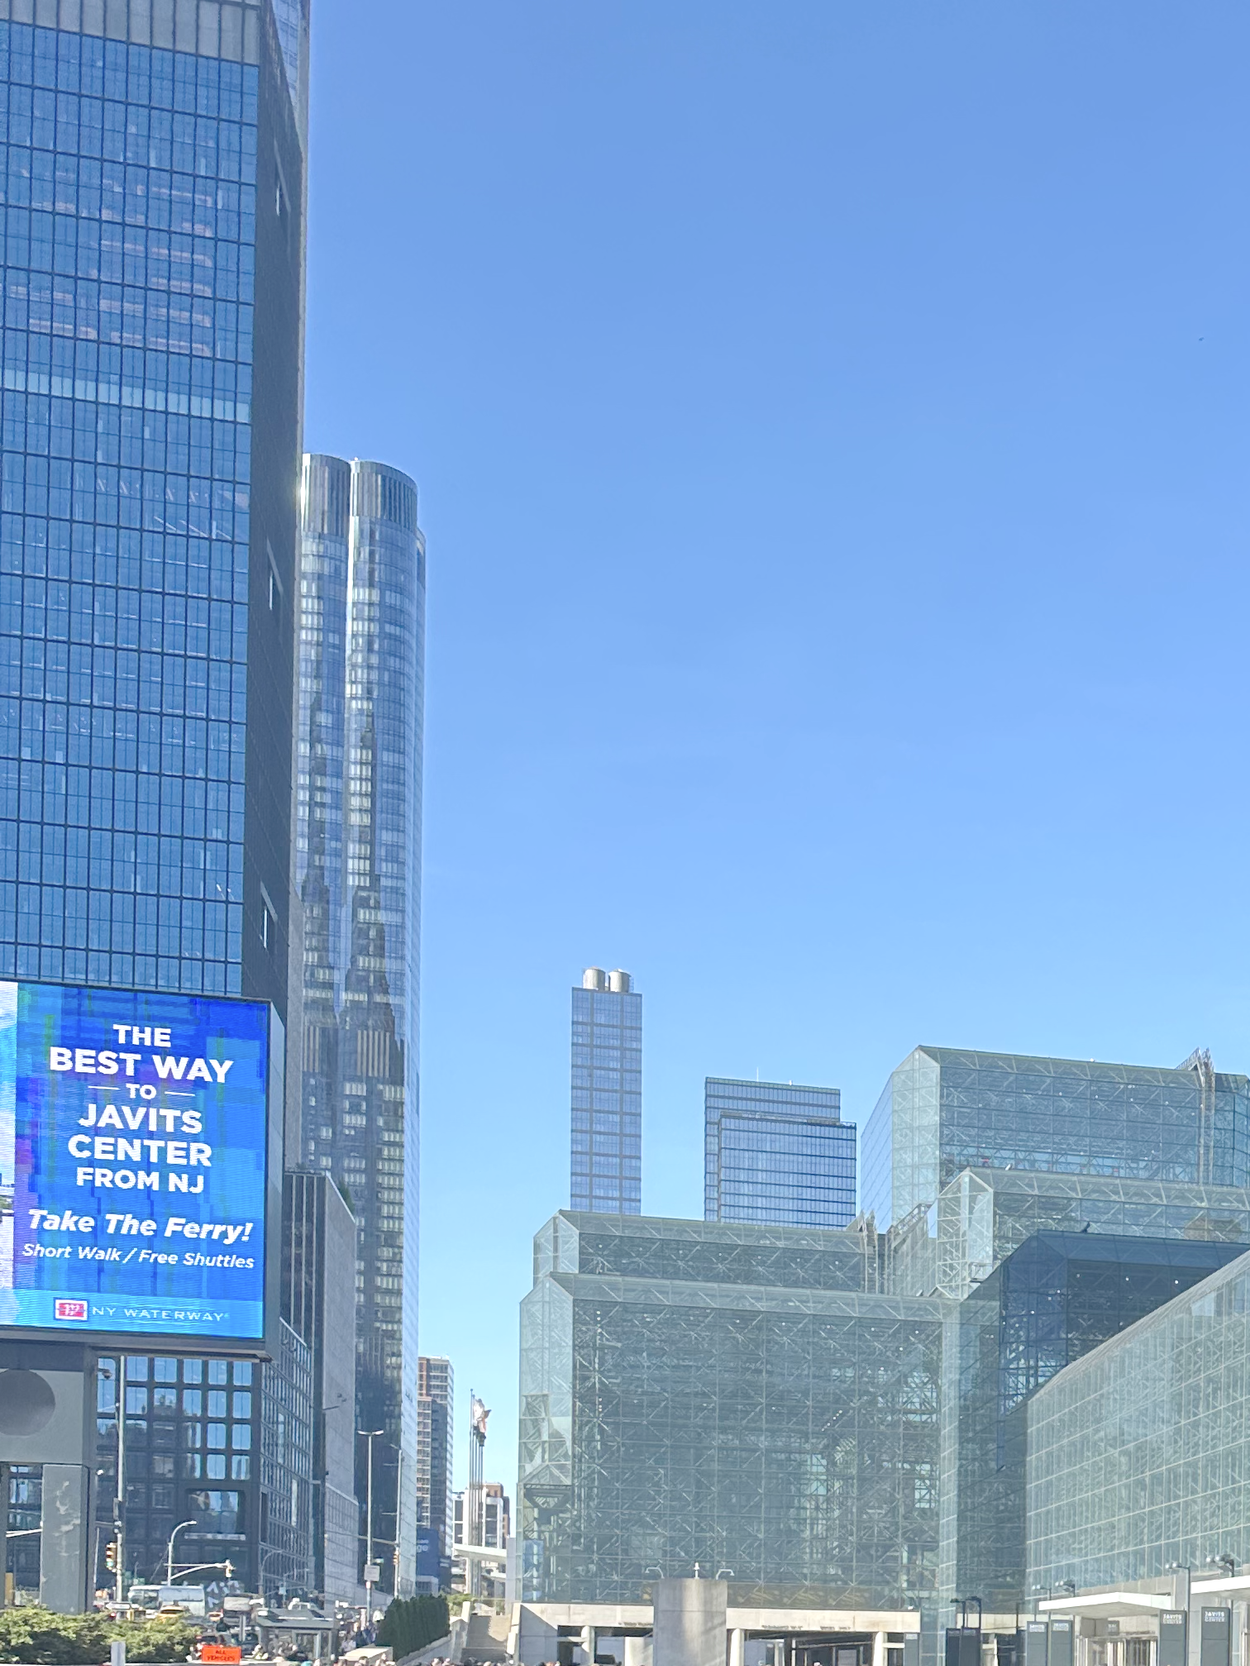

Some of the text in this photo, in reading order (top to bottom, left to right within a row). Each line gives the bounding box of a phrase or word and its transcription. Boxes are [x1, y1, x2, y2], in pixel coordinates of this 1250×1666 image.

[112, 1024, 172, 1047] THE
[49, 1047, 234, 1083] BEST WAY
[126, 1083, 157, 1100] TO
[77, 1104, 202, 1134] JAVITS
[67, 1135, 212, 1167] CENTER
[76, 1166, 204, 1194] FROM NJ
[28, 1208, 254, 1245] Take The Ferry!
[22, 1243, 72, 1259] Short
[77, 1247, 121, 1262] Walk
[138, 1250, 178, 1265] Free
[182, 1252, 255, 1270] Shuttles
[92, 1306, 224, 1322] NY WATERWAY
